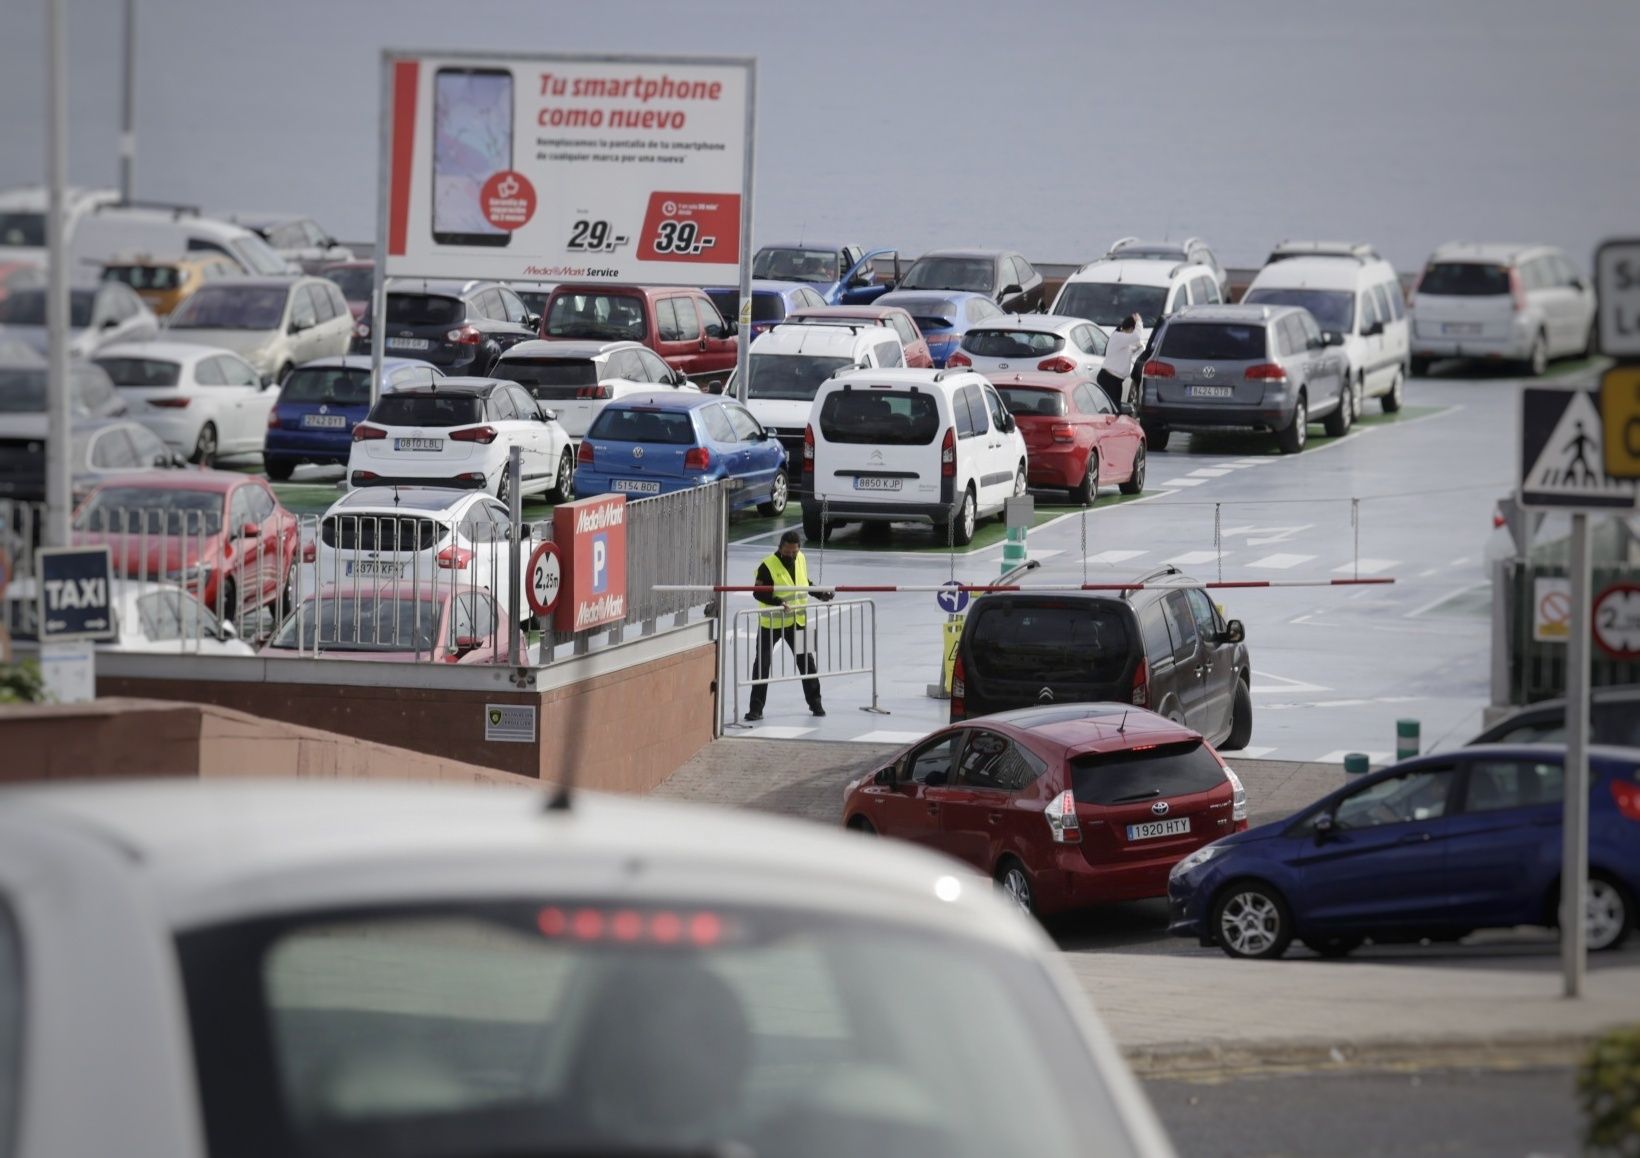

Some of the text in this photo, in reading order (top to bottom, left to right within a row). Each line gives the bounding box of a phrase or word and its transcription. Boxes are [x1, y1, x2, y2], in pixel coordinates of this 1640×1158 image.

[540, 74, 722, 102] Tu smartphone
[538, 107, 686, 130] como nuevo
[671, 141, 726, 153] smartphone
[567, 220, 626, 250] 29.-
[655, 221, 715, 253] 39.-
[586, 267, 619, 277] Service
[400, 439, 422, 449] 0810
[617, 480, 639, 491] 5154
[859, 479, 900, 489] 8850 KJP
[593, 540, 606, 588] P
[45, 577, 107, 611] TAXI
[1135, 819, 1188, 837] 1920 HTY
